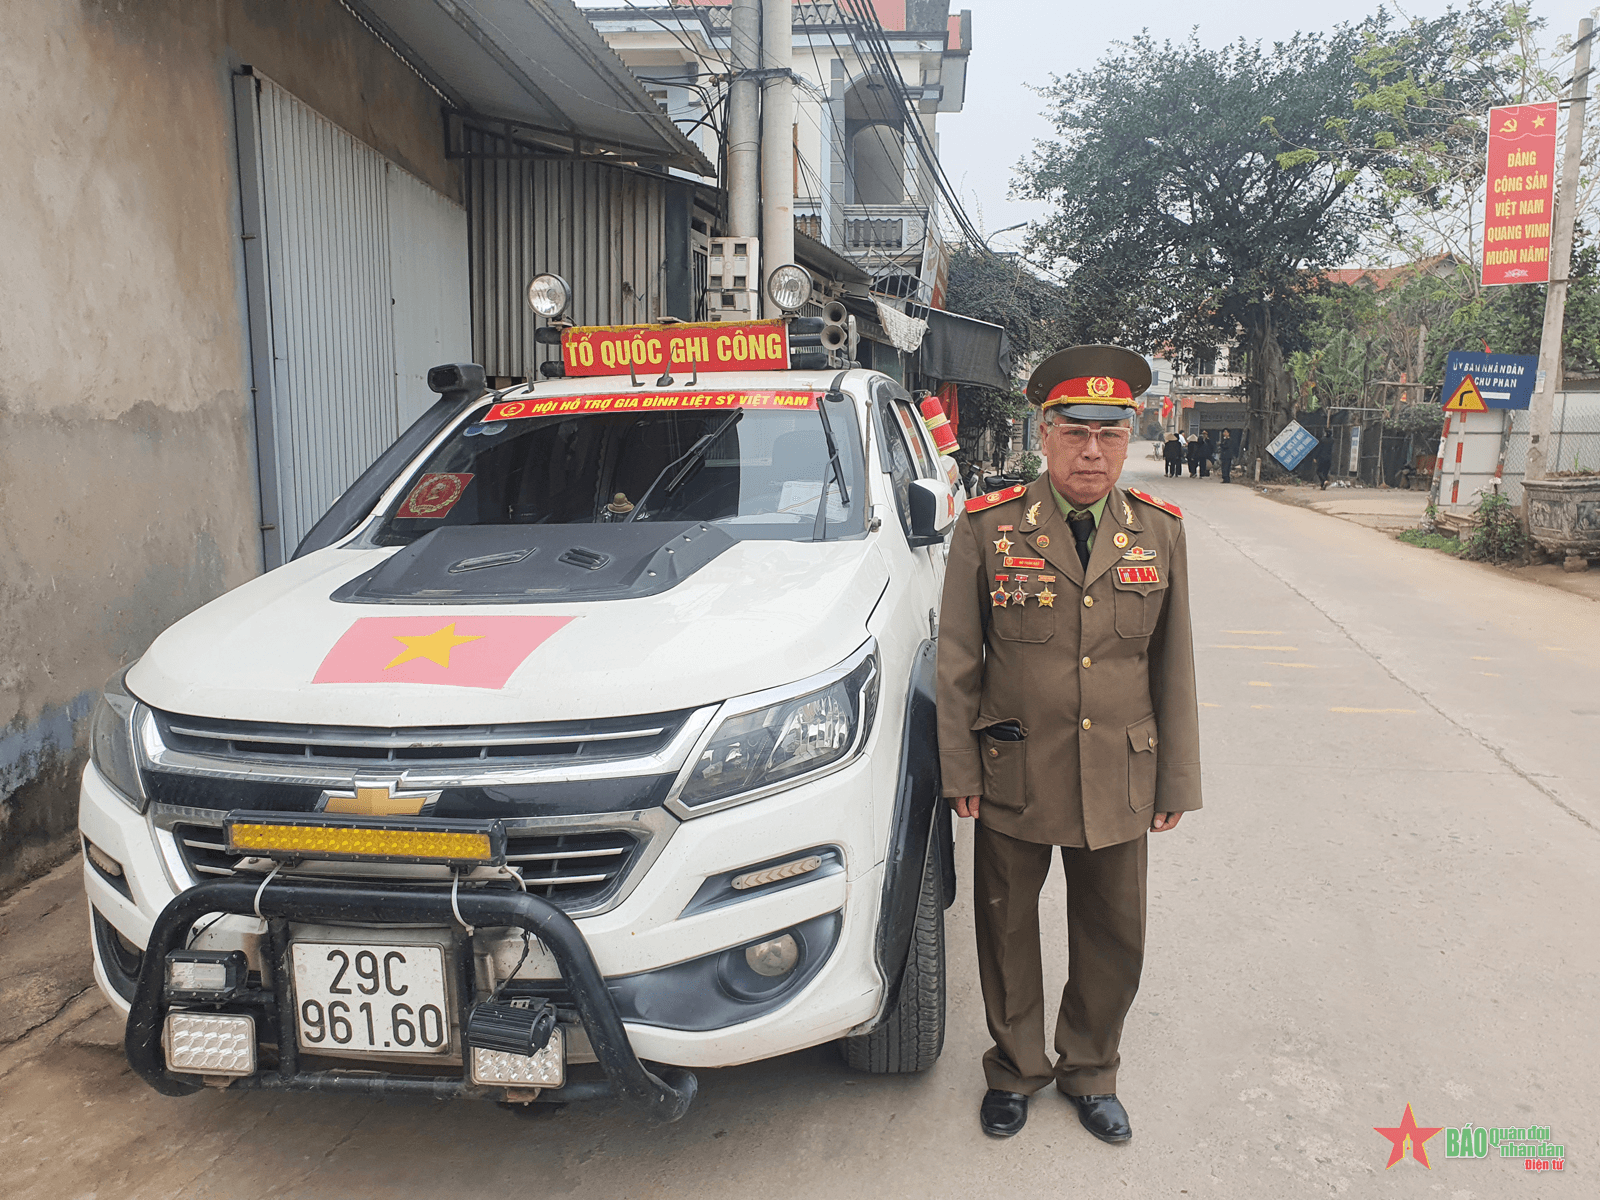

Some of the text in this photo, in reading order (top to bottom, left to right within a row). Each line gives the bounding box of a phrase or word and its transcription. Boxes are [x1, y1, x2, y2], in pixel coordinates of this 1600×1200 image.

[1508, 148, 1537, 168] ĐẢNG
[1494, 170, 1548, 196] CỘNG SẢN
[1495, 199, 1544, 219] VIỆT NAM
[1487, 223, 1549, 243] QUANG VINH
[1486, 245, 1548, 266] MUÔN NĂM!
[600, 330, 663, 369] QUỐC
[670, 336, 710, 363] GHI
[717, 329, 782, 361] CÔNG
[1475, 376, 1491, 387] CHU
[1493, 377, 1517, 388] PHAN
[531, 400, 559, 414] HỘI
[584, 397, 613, 411] TRỢ
[614, 397, 639, 409] GIA
[642, 395, 679, 407] ĐÌNH
[681, 395, 713, 408] LIỆT
[739, 393, 772, 407] VIỆT
[773, 395, 809, 406] NAM
[326, 949, 409, 997] 29C
[301, 998, 444, 1048] 961.60
